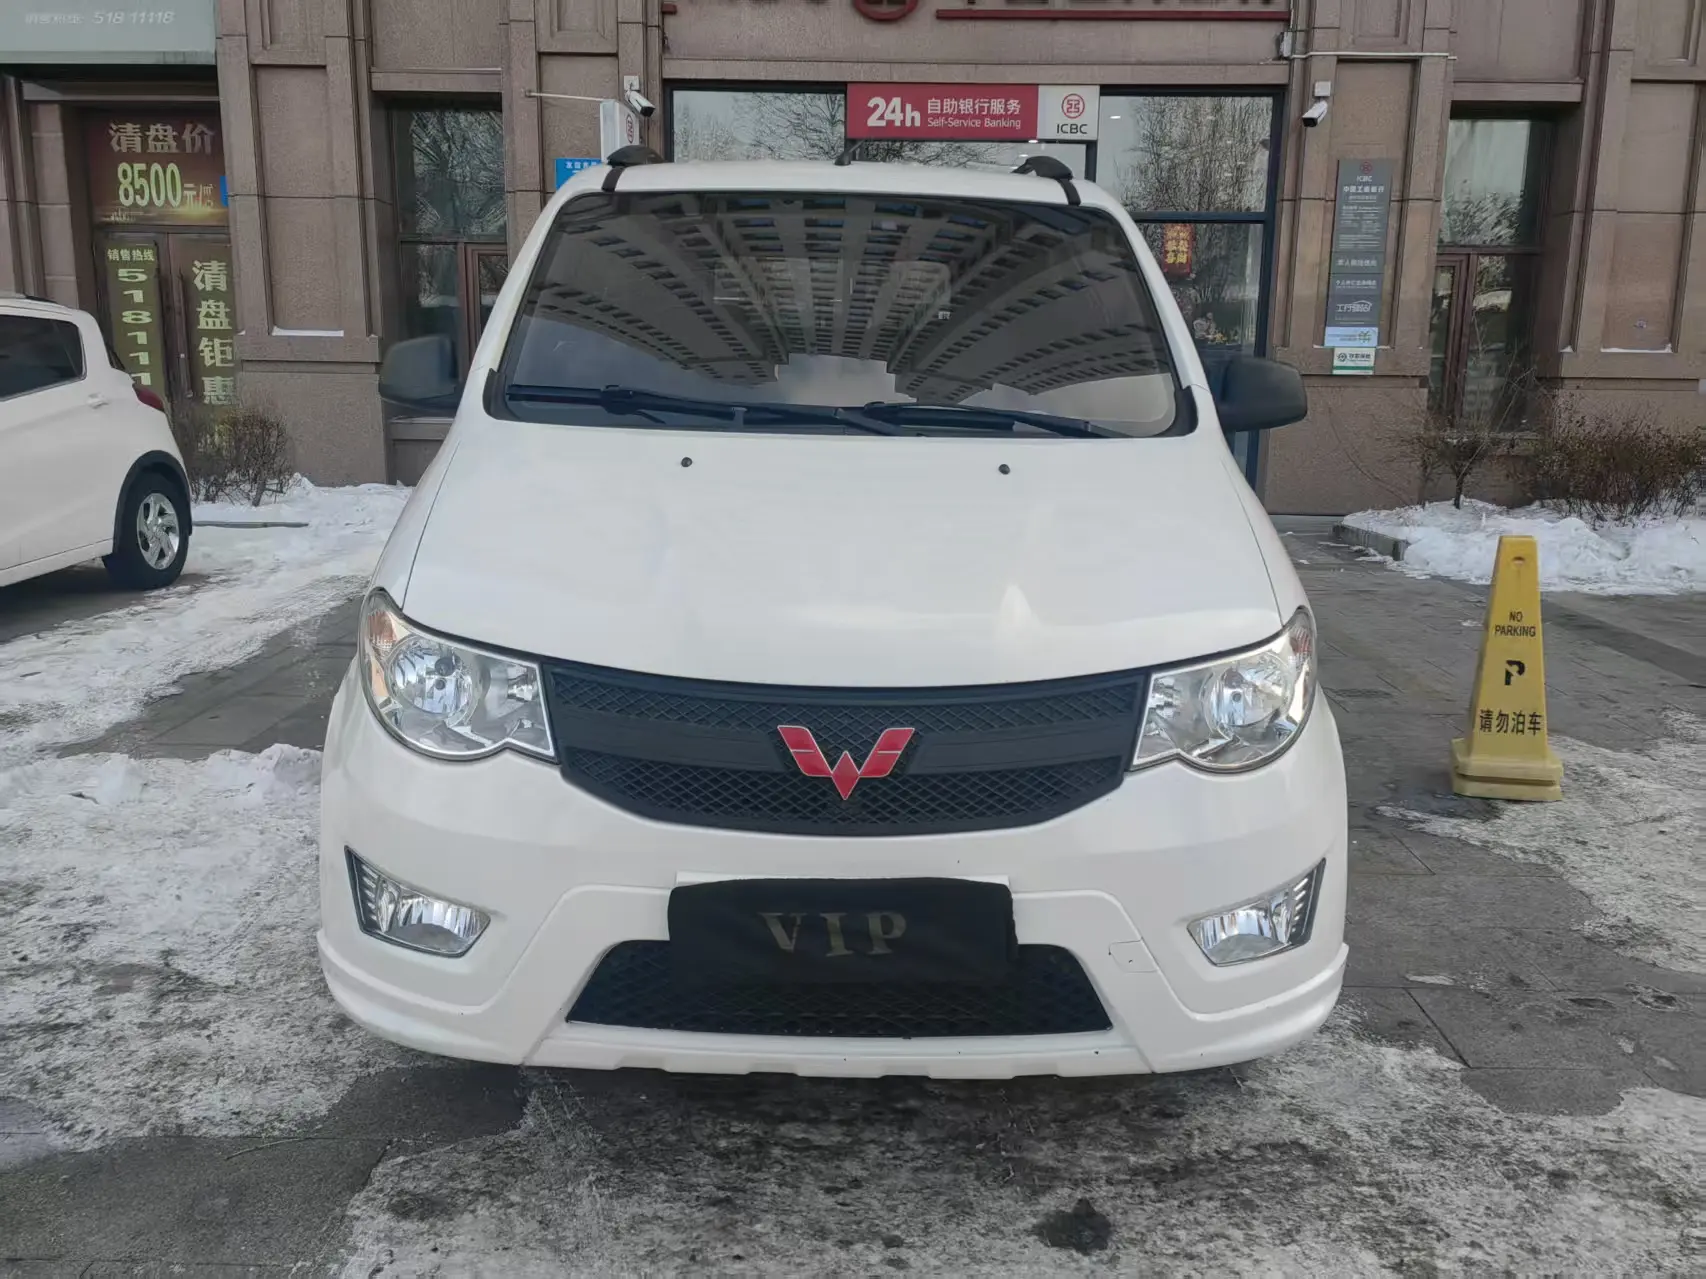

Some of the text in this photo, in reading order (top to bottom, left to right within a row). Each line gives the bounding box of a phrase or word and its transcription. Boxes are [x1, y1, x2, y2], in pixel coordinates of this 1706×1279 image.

[91, 11, 125, 24] 518
[867, 96, 921, 127] 24h
[927, 98, 1021, 115] 自助银行服务
[927, 117, 1022, 129] Self-Service Banking
[1056, 123, 1088, 134] ICBC
[108, 122, 214, 154] 清盘价
[107, 249, 154, 261] 销售热线
[1508, 611, 1524, 622] NO
[1494, 625, 1536, 637] PARKING
[1478, 708, 1543, 737] 请勿泊车
[758, 911, 907, 957] VIP
